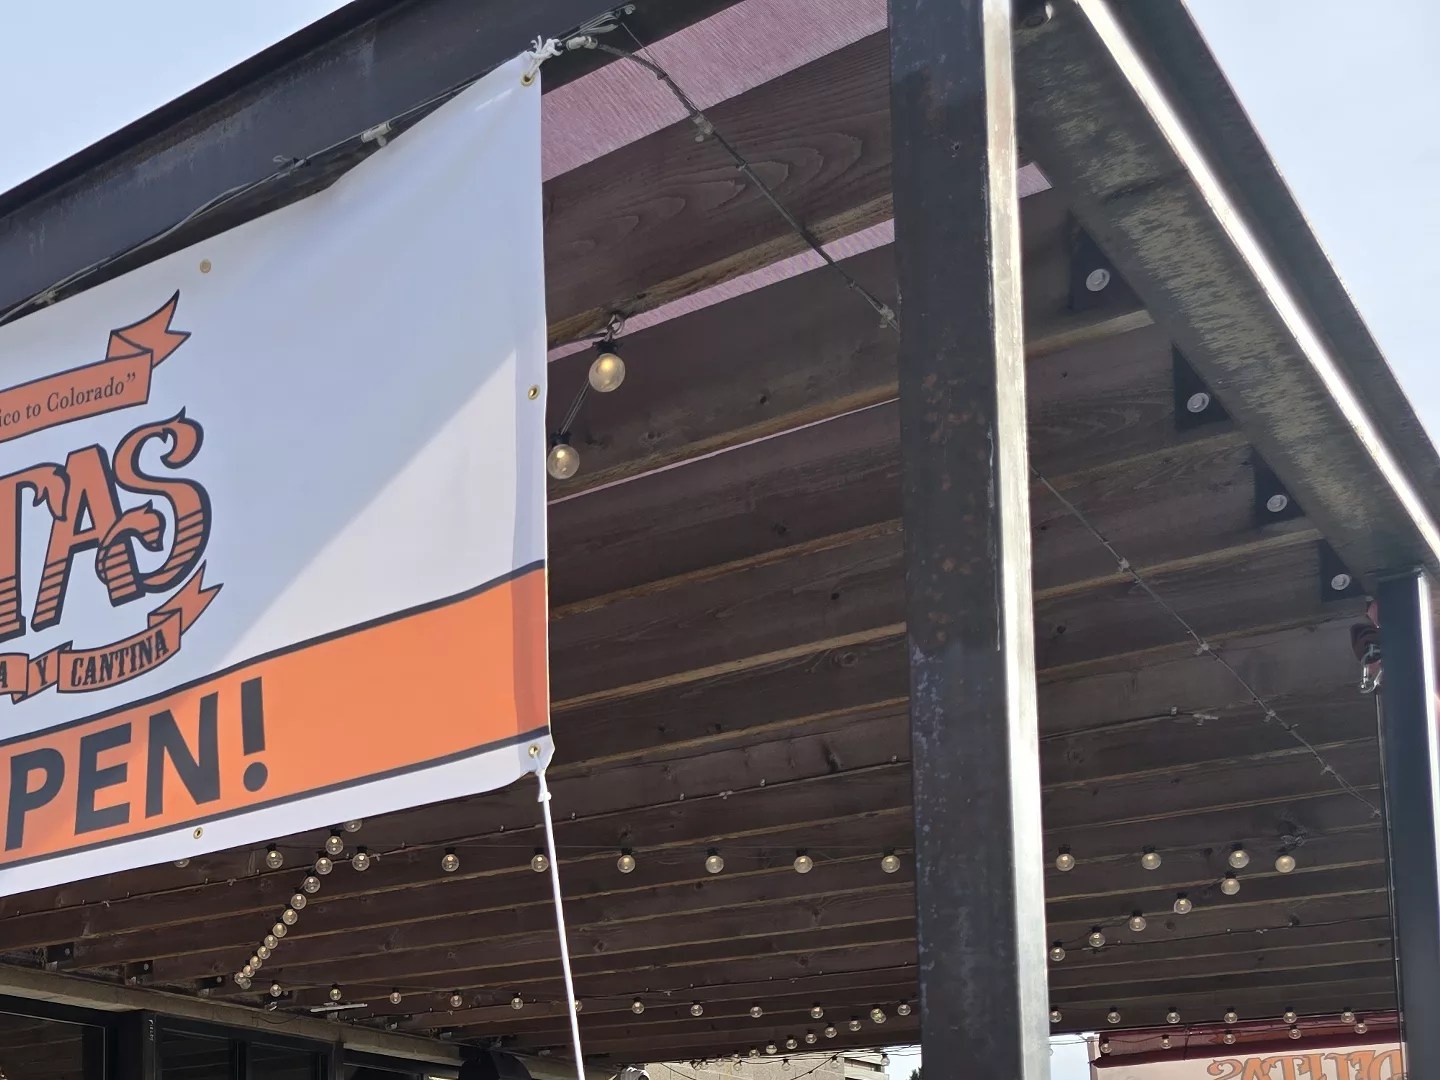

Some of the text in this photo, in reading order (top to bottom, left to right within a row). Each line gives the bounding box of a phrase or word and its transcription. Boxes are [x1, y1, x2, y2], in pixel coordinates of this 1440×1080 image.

[25, 402, 42, 419] to
[35, 656, 50, 688] Y
[70, 627, 171, 688] CANTINA
